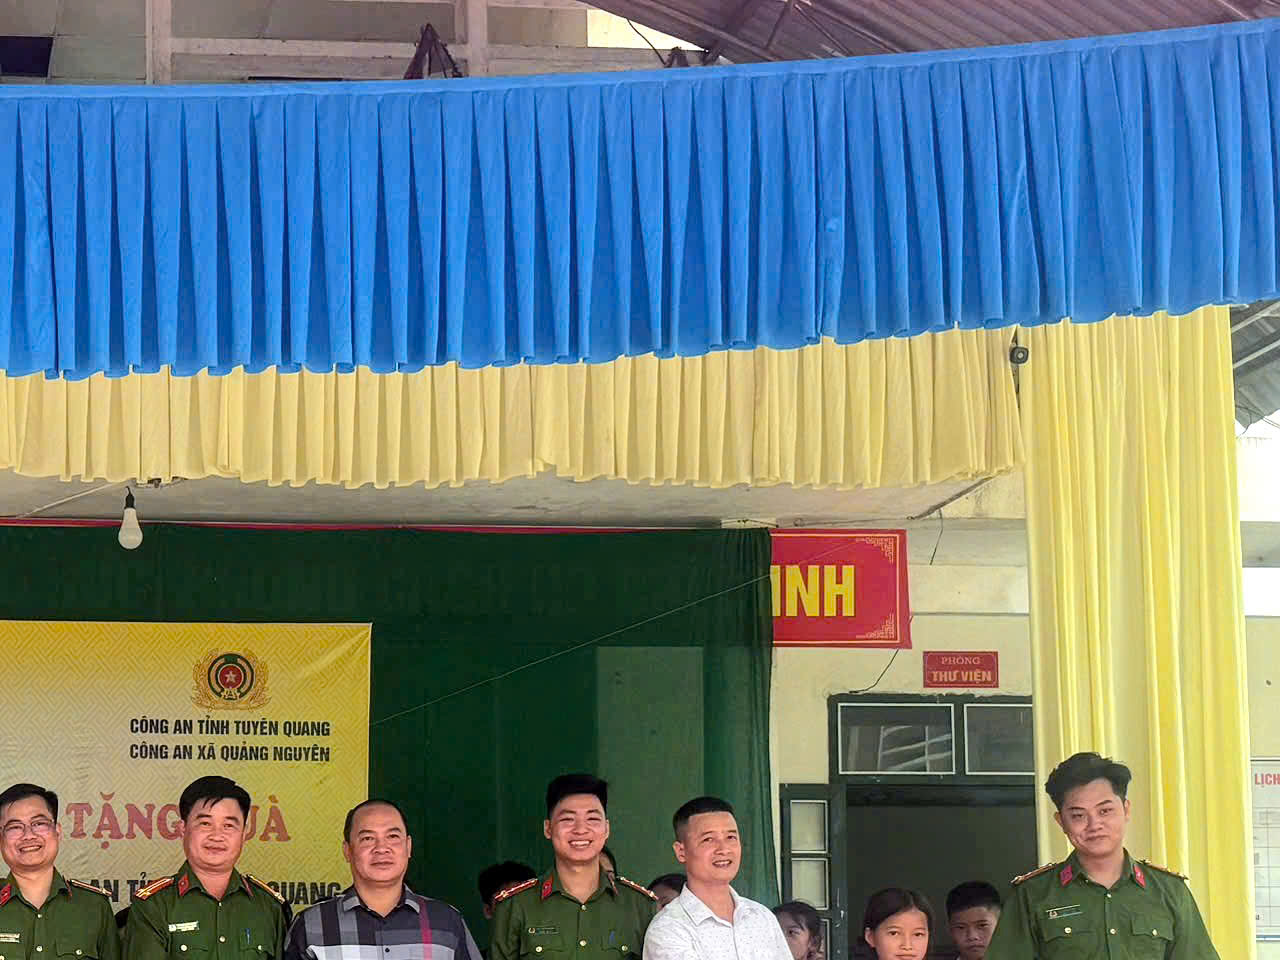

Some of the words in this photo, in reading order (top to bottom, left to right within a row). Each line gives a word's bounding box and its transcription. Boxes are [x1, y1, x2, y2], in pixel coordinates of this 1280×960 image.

[770, 565, 855, 616] INH
[931, 669, 958, 682] THƯ
[960, 668, 992, 684] VIỆN
[130, 715, 169, 734] CÔNG
[173, 719, 193, 735] AN
[197, 715, 230, 735] TỈNH
[234, 717, 279, 736] TUYÊN
[283, 721, 331, 737] QUANG
[130, 741, 169, 759] CÔNG
[173, 744, 193, 760] AN
[197, 742, 216, 760] XÃ
[220, 741, 269, 761] QUẢNG
[273, 744, 330, 762] NGUYÊN
[66, 792, 183, 849] TẶNG
